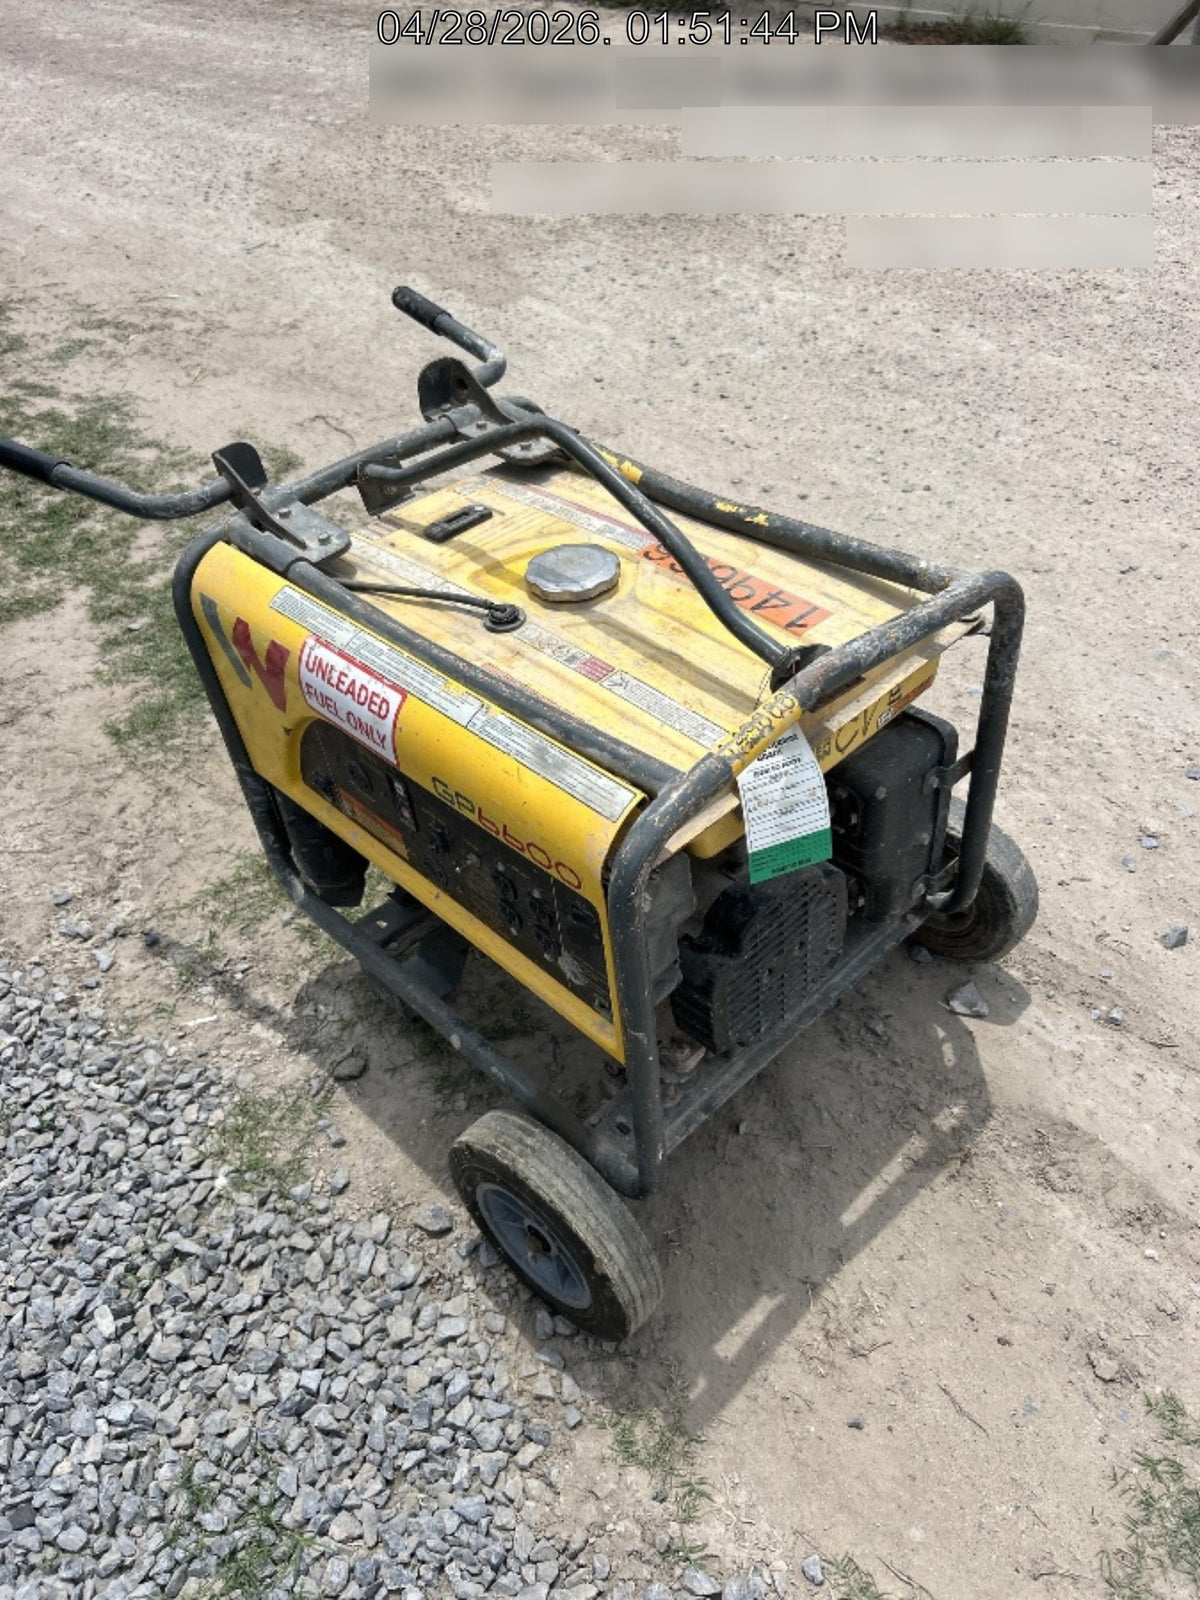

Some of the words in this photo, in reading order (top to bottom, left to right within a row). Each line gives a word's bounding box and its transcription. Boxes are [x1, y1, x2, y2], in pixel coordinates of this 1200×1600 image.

[304, 682, 345, 722] FUEL
[346, 710, 386, 750] ONLY
[305, 649, 390, 720] UNLEADED
